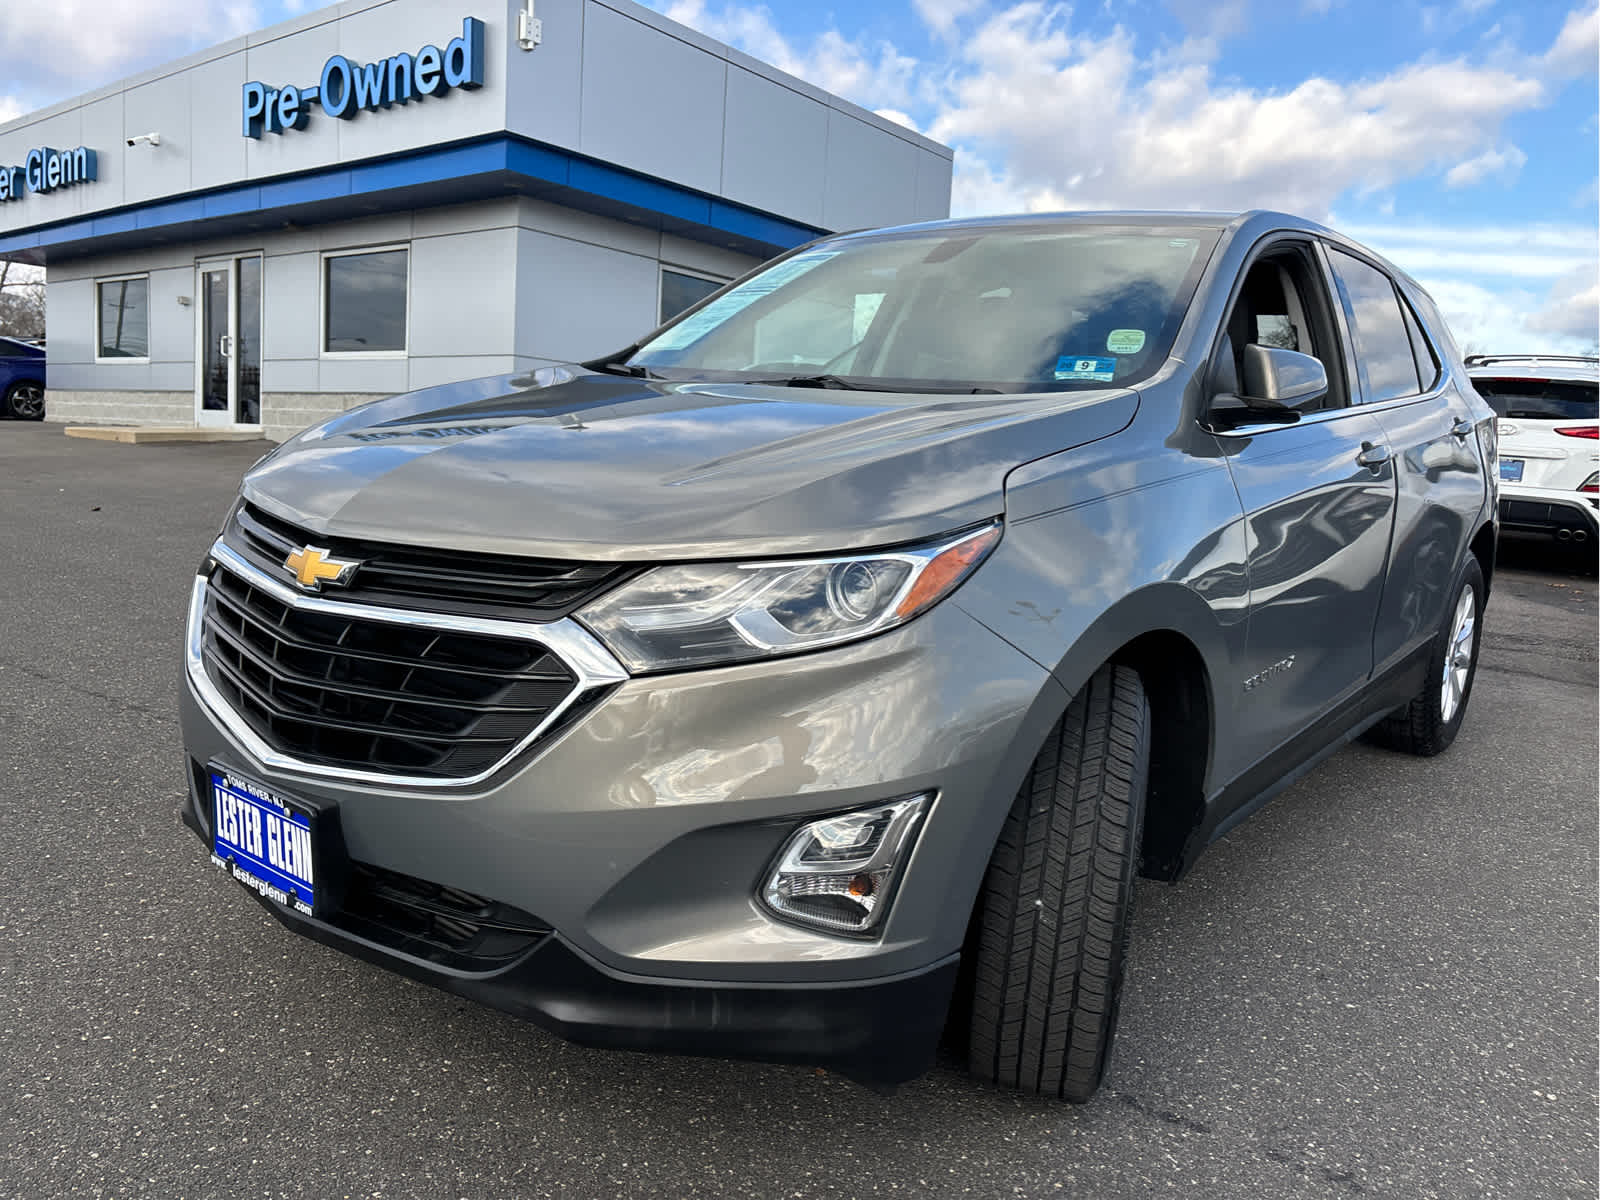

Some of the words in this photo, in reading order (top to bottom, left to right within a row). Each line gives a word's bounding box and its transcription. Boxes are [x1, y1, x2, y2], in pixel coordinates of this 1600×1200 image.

[242, 16, 480, 140] Pre-Owned
[25, 145, 93, 194] Glenn
[1081, 361, 1090, 370] 9
[226, 774, 247, 792] TOMS
[215, 788, 263, 859] LESTER
[266, 813, 313, 885] GLENN
[232, 862, 288, 905] lesterglenn
